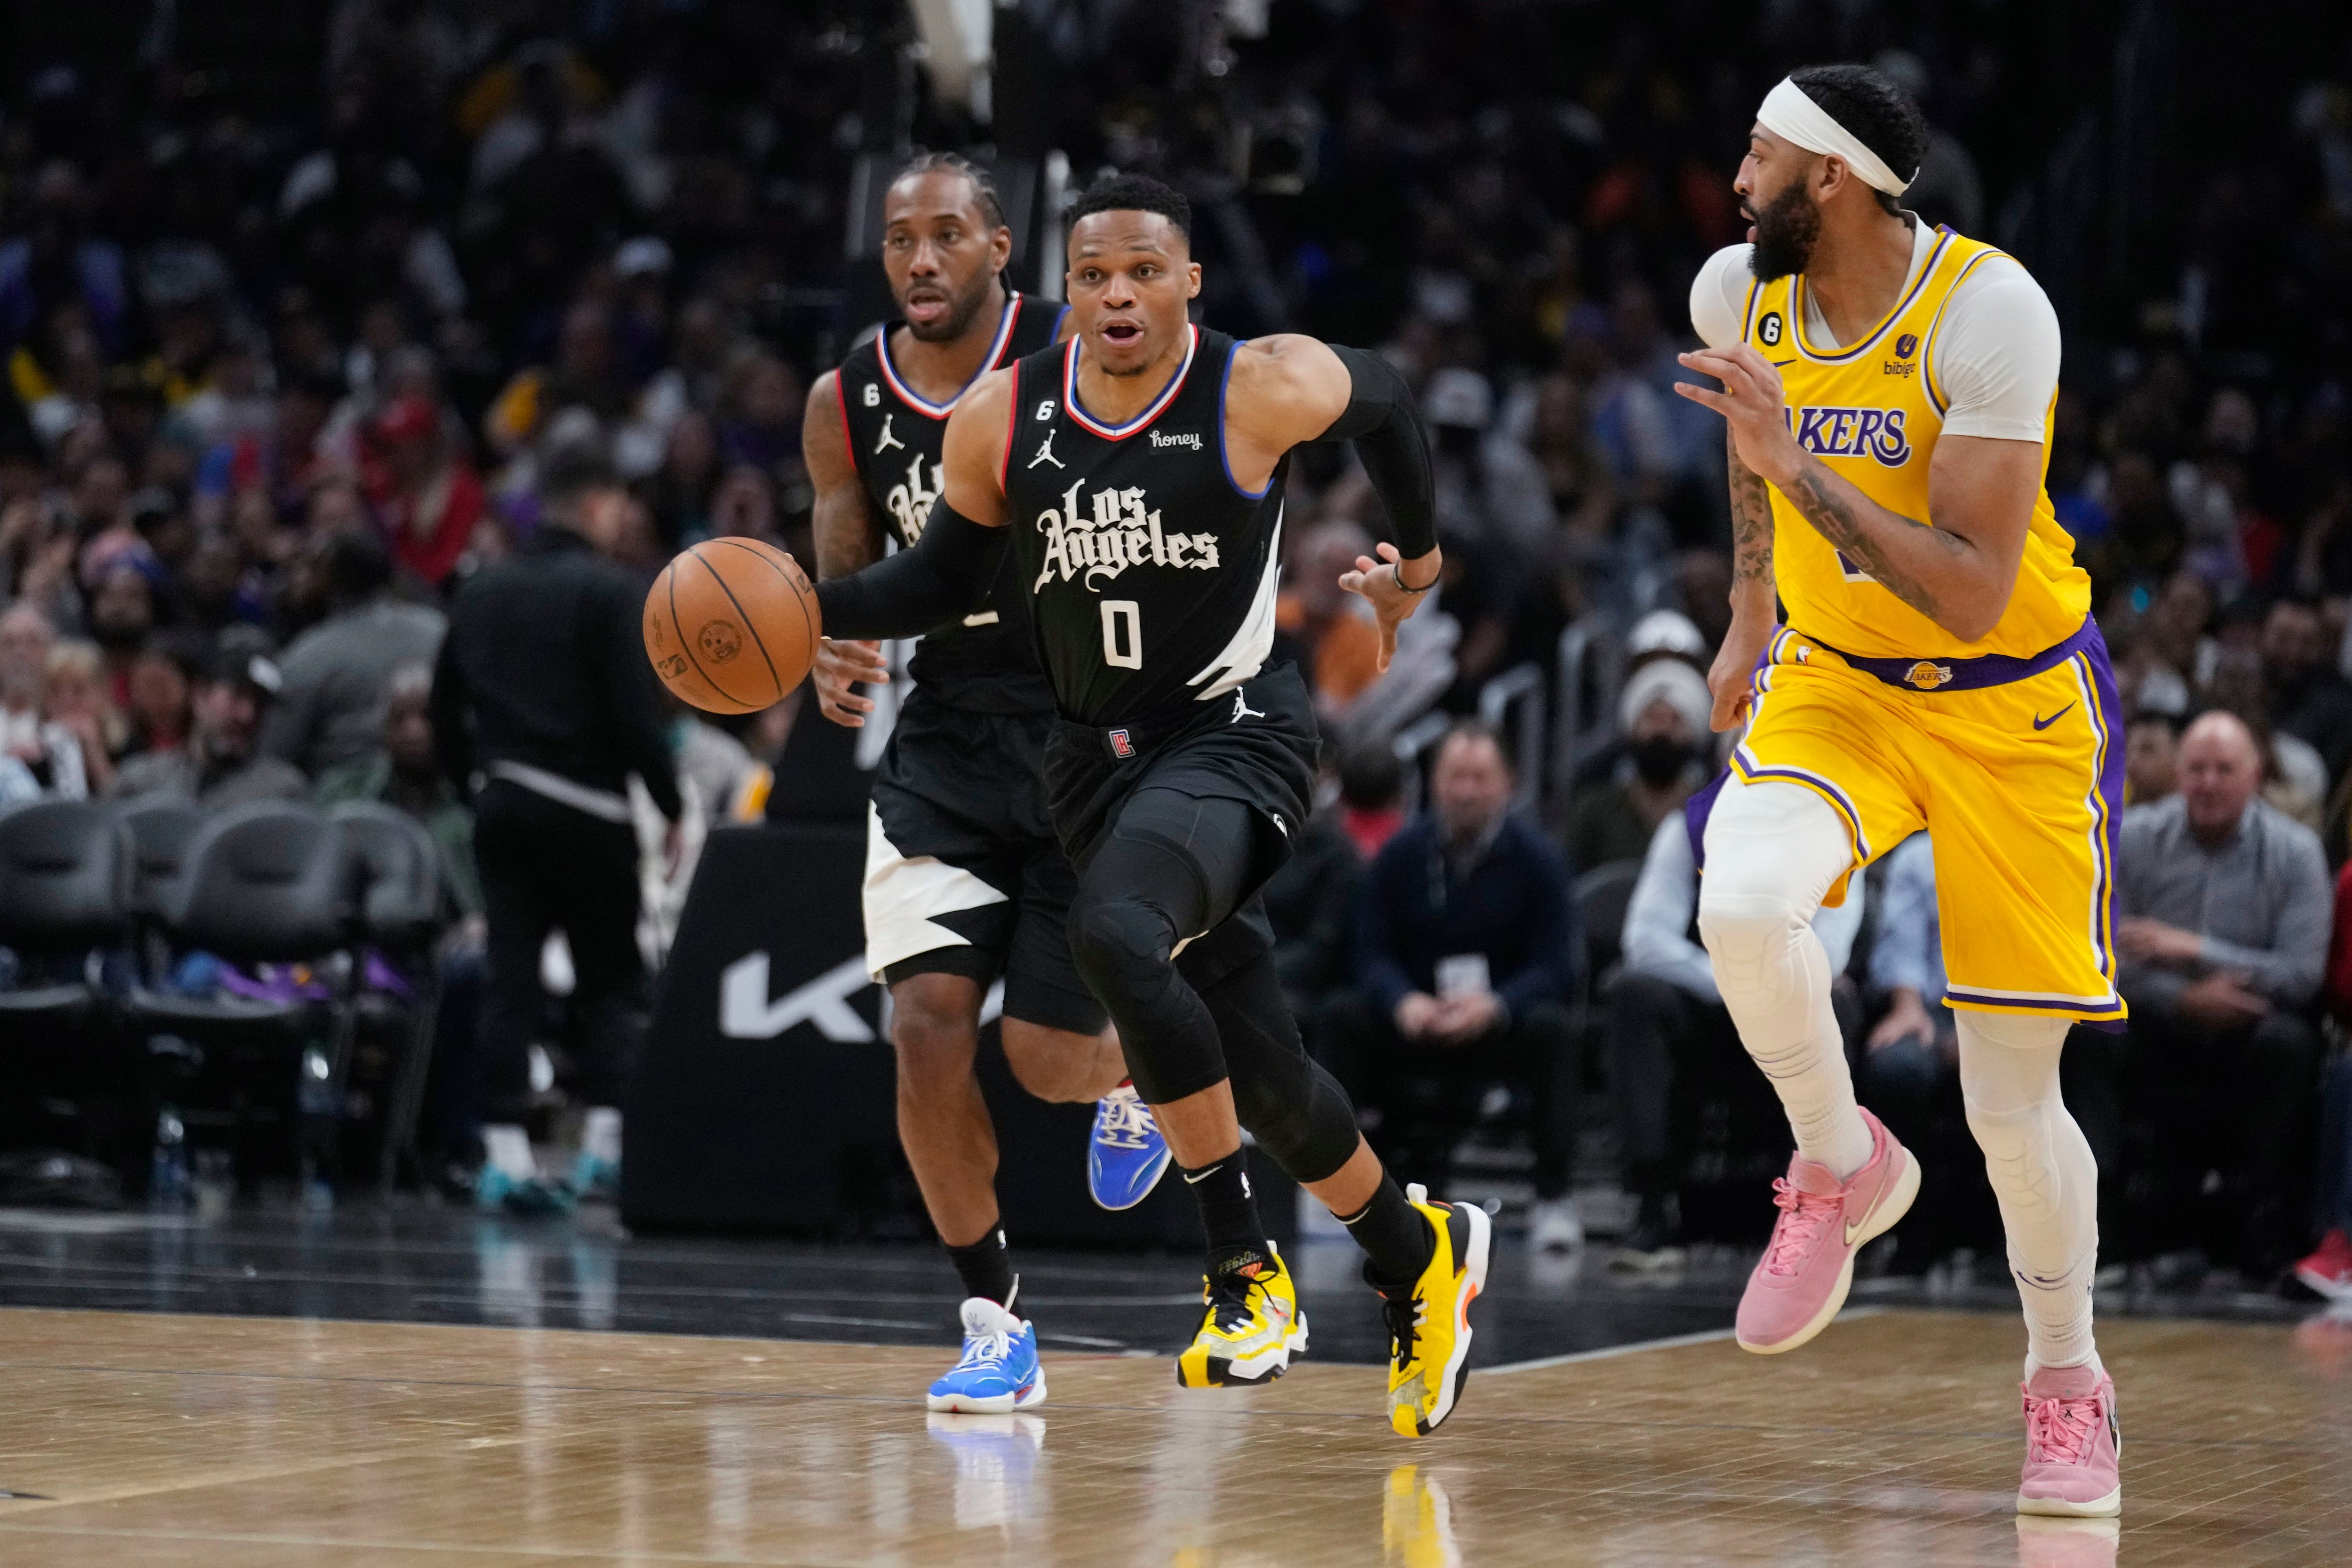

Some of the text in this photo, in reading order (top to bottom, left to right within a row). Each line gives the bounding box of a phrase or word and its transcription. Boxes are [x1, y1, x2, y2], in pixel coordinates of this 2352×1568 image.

[1764, 317, 1780, 342] 6
[864, 383, 880, 407] 6
[1036, 401, 1055, 421] 6
[1149, 430, 1203, 451] honey
[1783, 406, 1913, 469] KERS
[1062, 478, 1147, 534] Los
[1034, 509, 1220, 595] Angeles
[1100, 600, 1142, 670] 0
